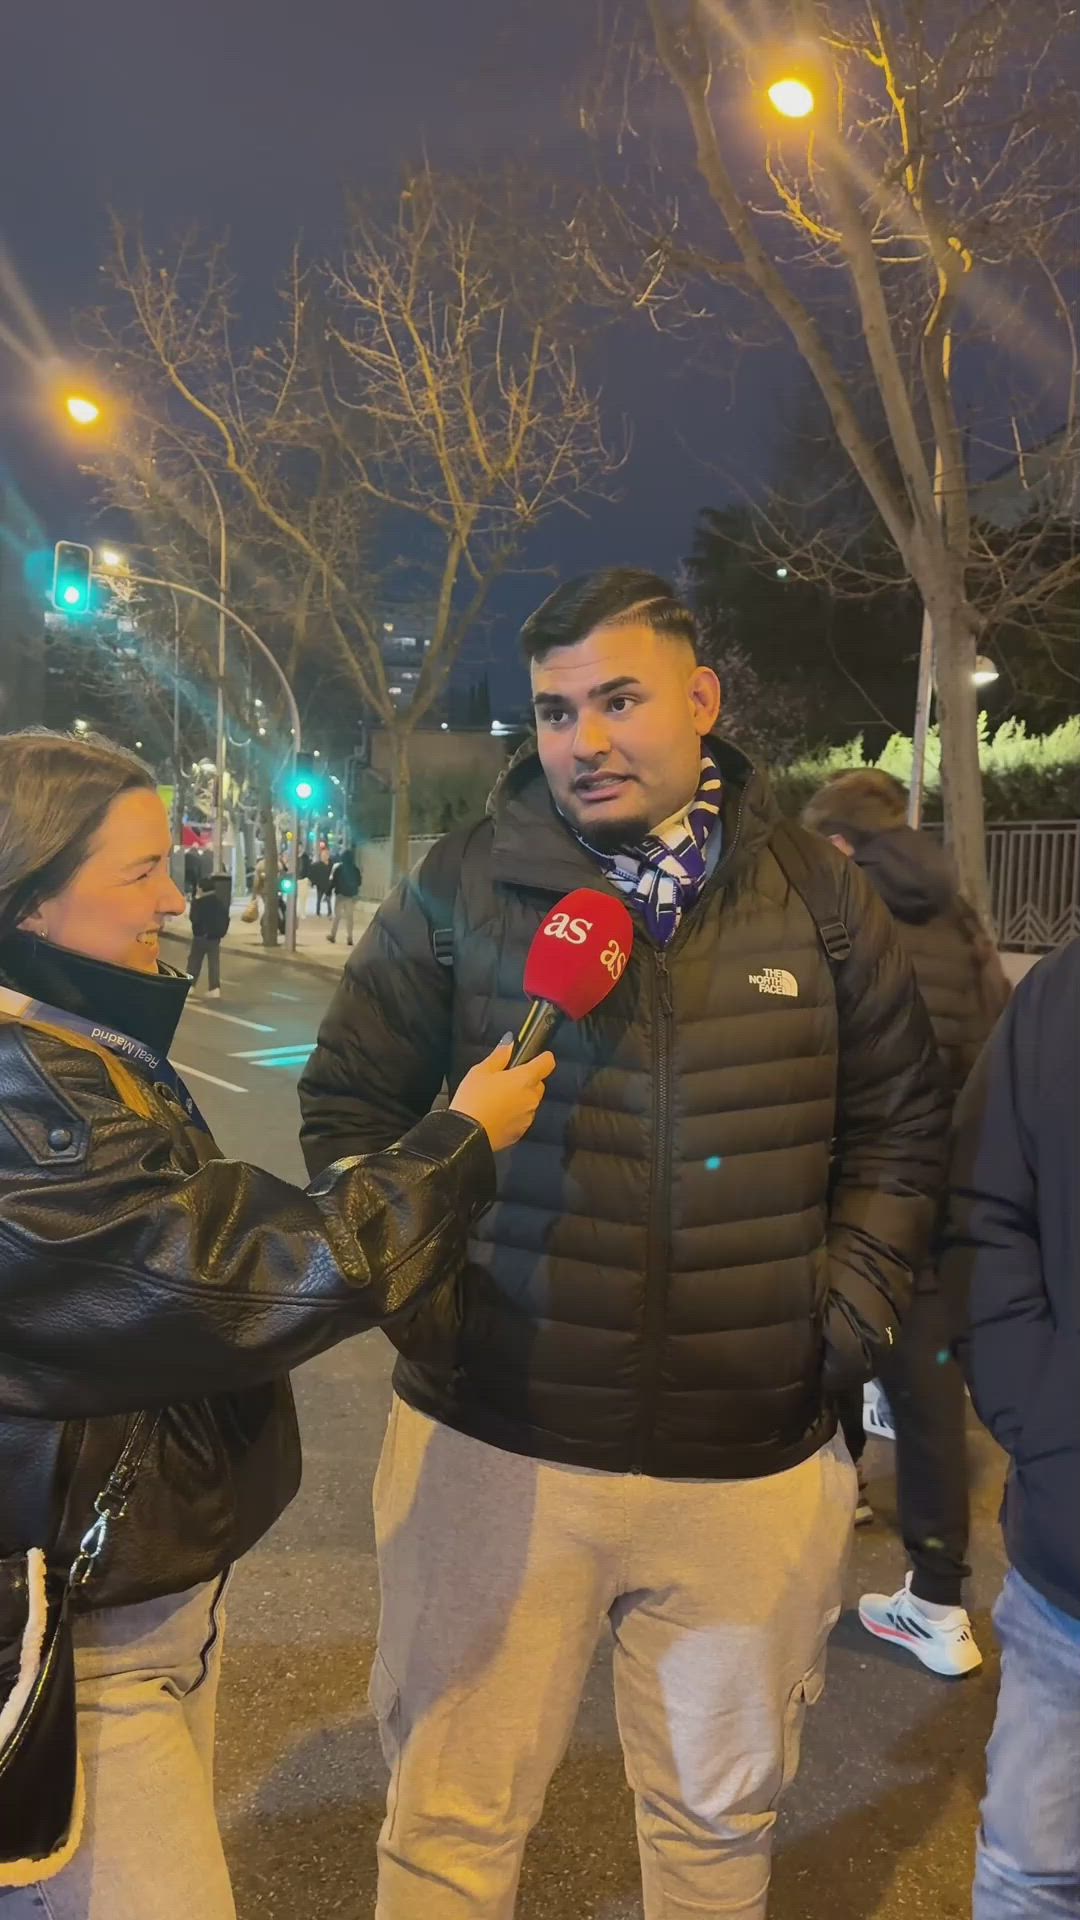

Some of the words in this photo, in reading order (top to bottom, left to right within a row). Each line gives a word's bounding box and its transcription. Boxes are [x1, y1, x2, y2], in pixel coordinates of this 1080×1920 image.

[543, 912, 594, 945] as
[600, 939, 626, 980] as
[748, 974, 782, 986] NORTH
[762, 967, 782, 978] THE
[758, 983, 783, 995] FACE
[91, 1027, 135, 1055] Madrid
[133, 1047, 160, 1069] Real
